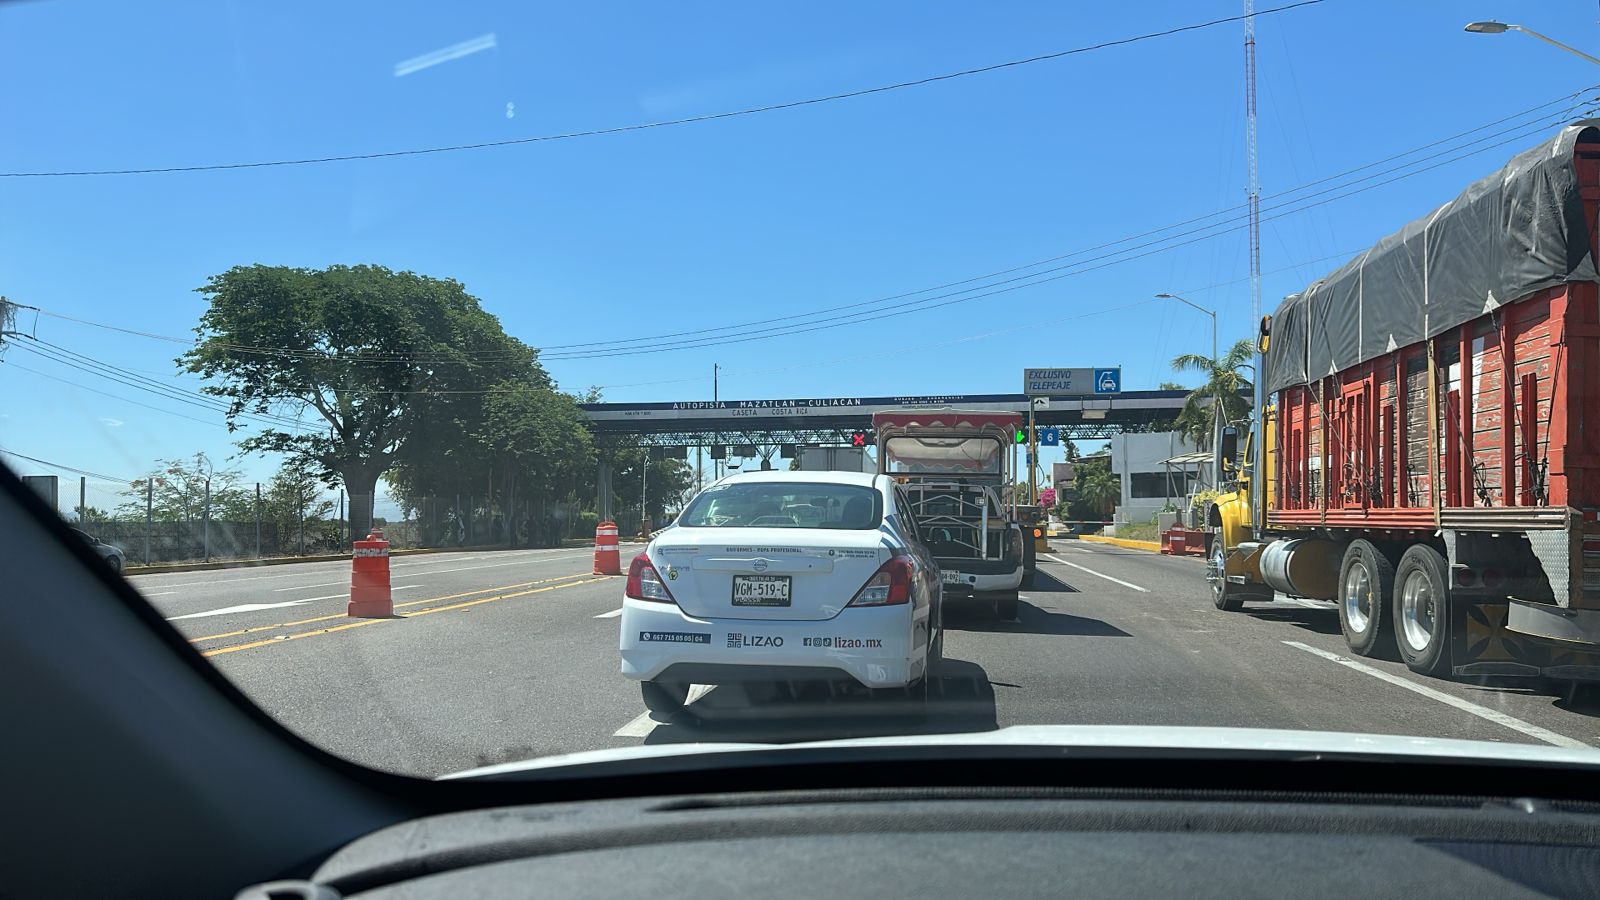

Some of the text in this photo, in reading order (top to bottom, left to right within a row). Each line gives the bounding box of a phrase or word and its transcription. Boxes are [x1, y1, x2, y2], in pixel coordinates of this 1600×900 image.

[1028, 370, 1072, 379] EXCLUSIVO
[1028, 381, 1072, 390] TELEPEAJE
[740, 400, 795, 408] MAZATLAN
[808, 399, 861, 407] CULIACAN
[1047, 432, 1054, 442] 6
[735, 582, 788, 597] VGM-519-C
[743, 636, 784, 647] LIZAO
[834, 637, 882, 648] lizao.mx
